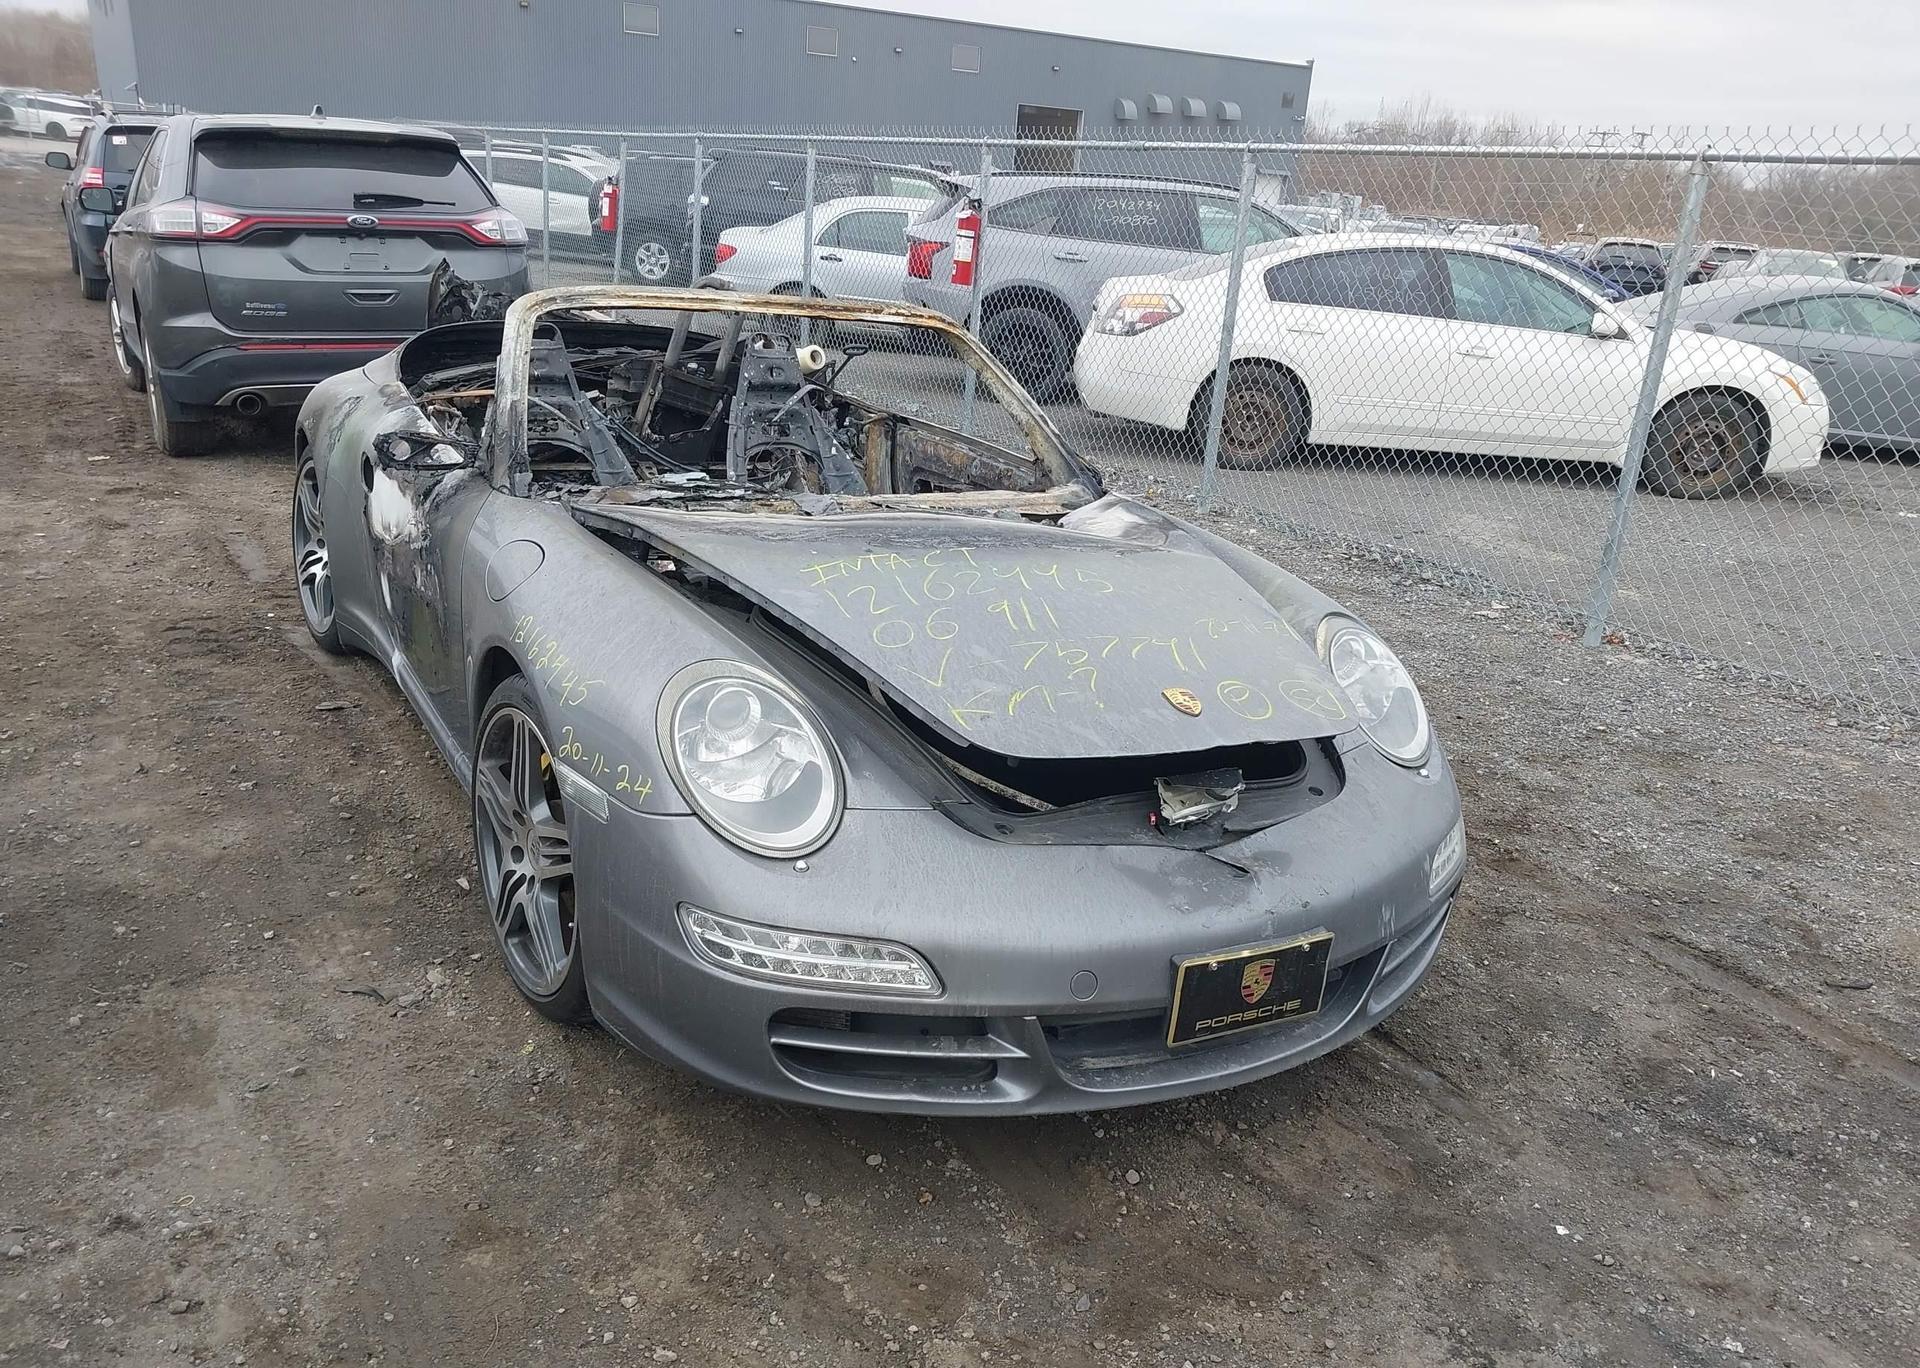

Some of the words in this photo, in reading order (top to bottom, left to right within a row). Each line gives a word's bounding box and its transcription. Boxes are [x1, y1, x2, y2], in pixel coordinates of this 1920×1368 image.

[824, 564, 1114, 620] 12162445
[873, 607, 959, 648] 06
[986, 596, 1061, 631] 911
[510, 614, 606, 706] 12162445
[558, 726, 653, 804] 20-11-24
[1194, 999, 1302, 1031] PORSCHE
